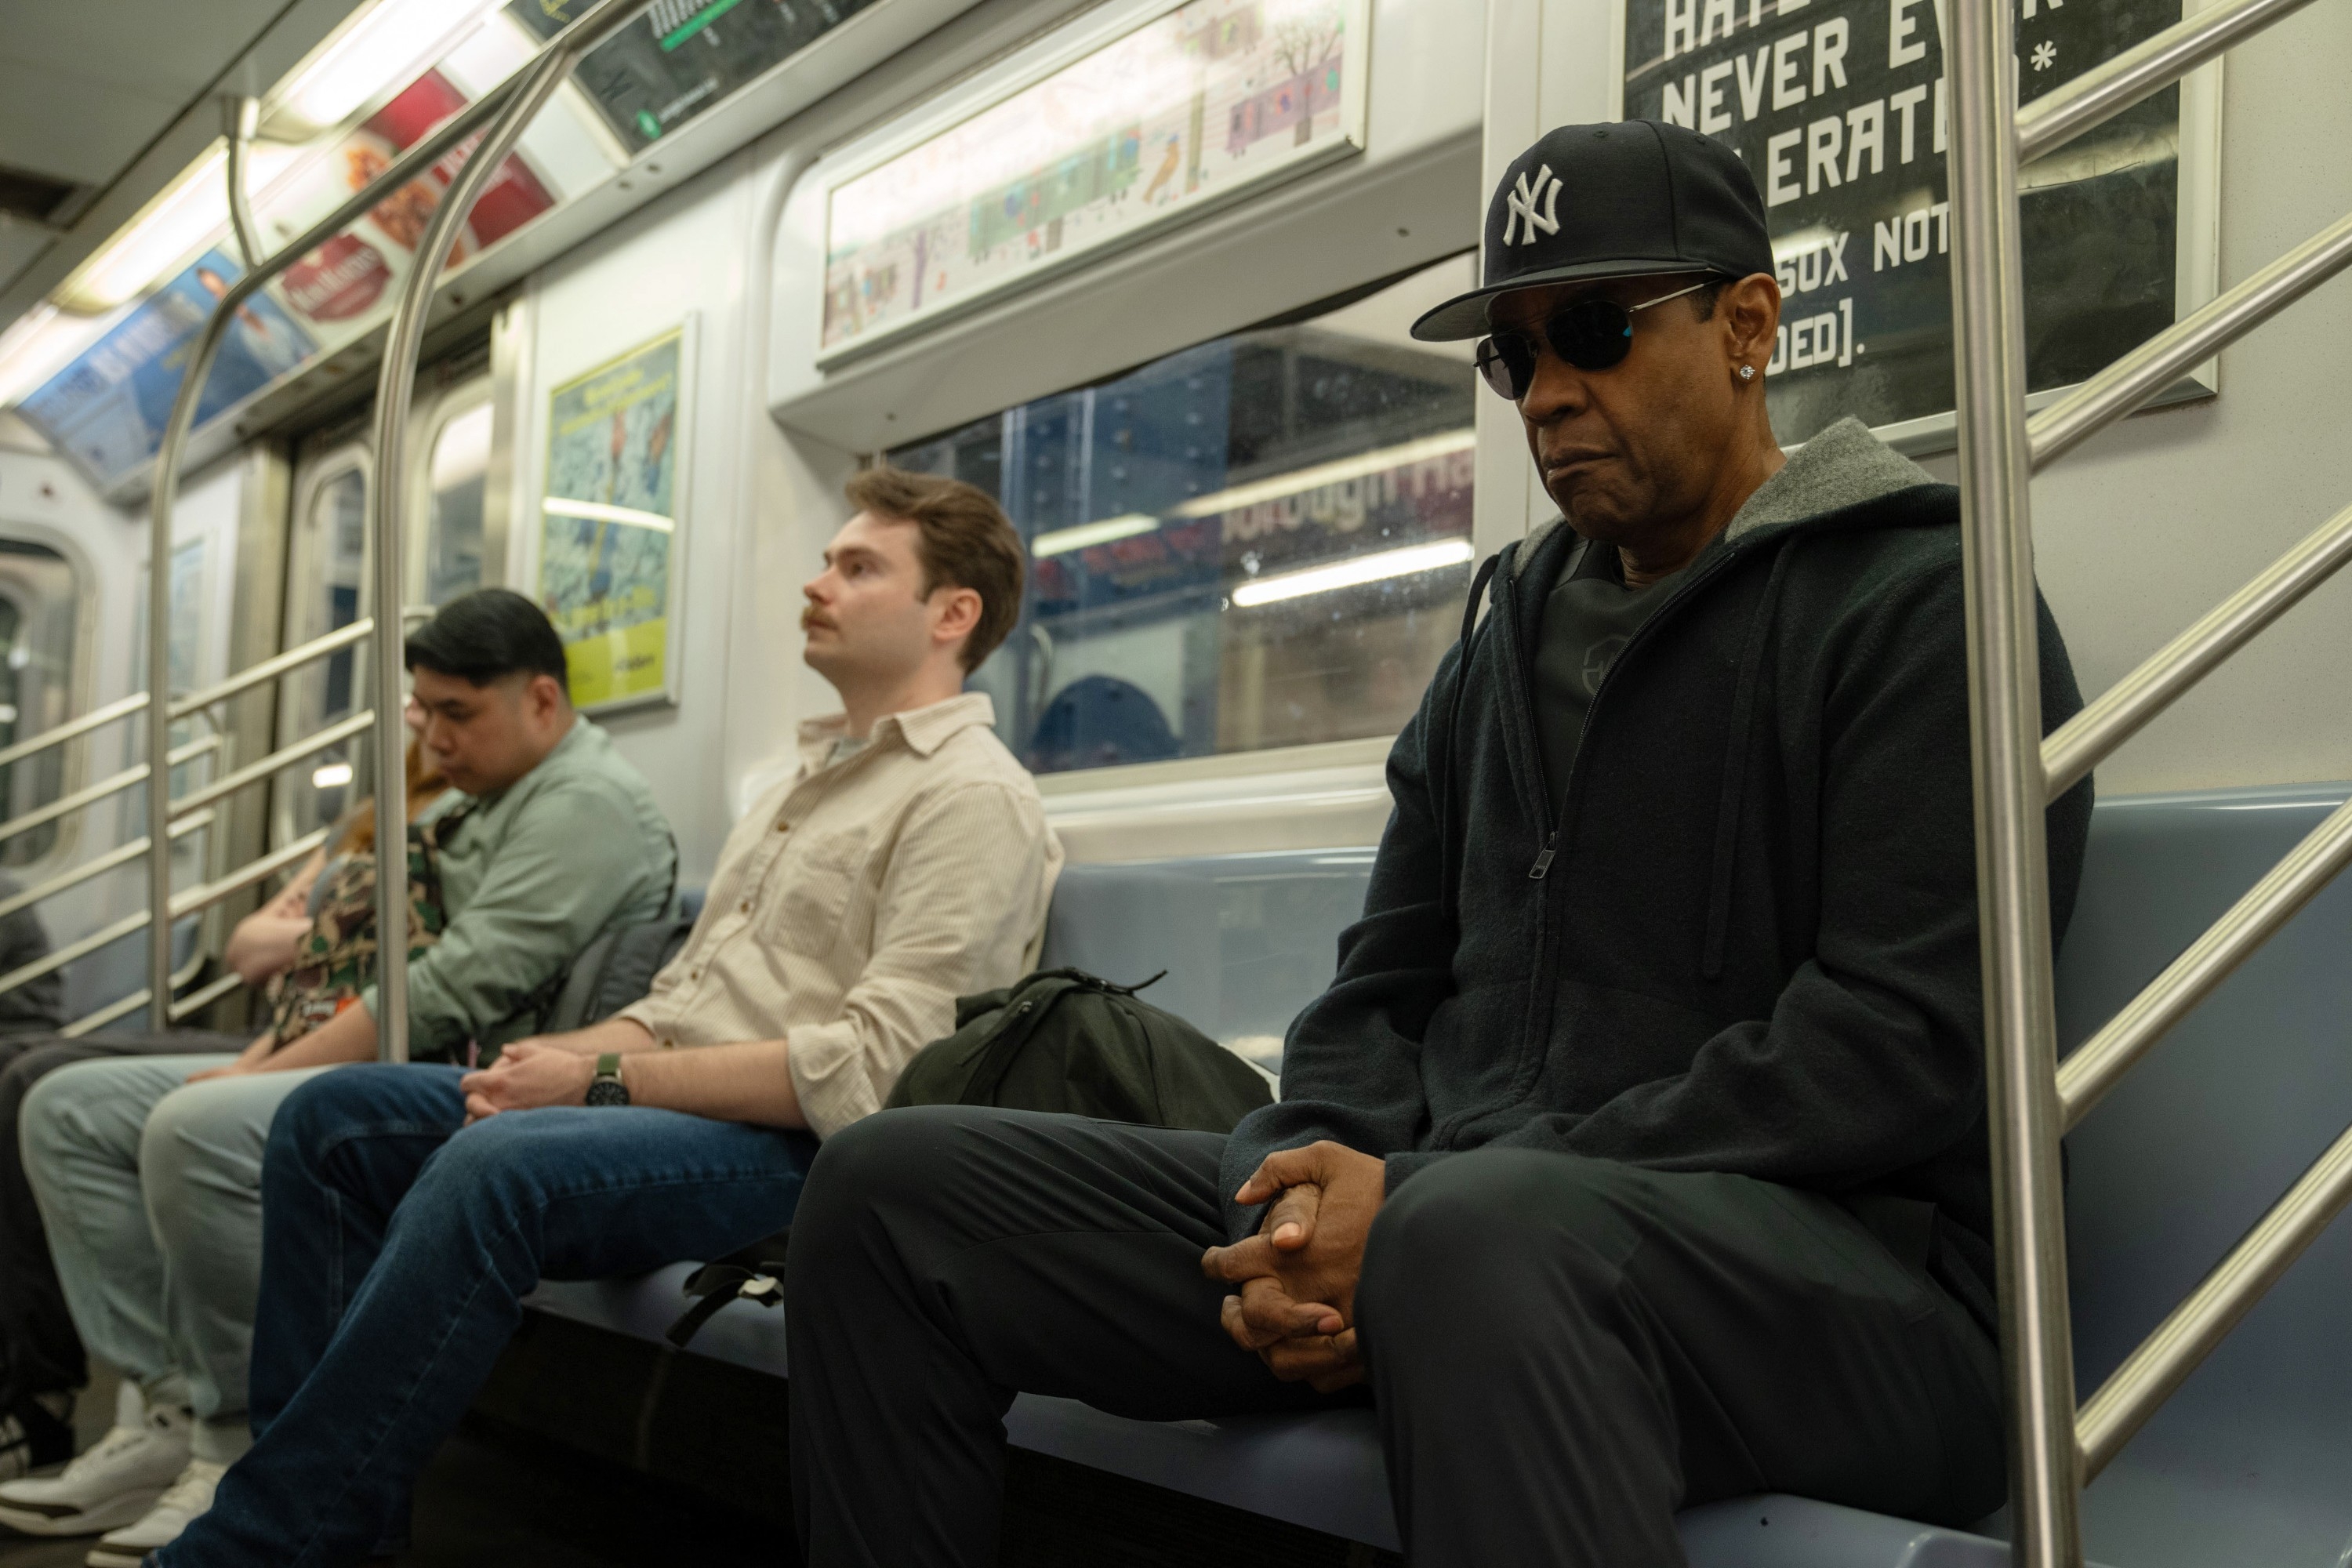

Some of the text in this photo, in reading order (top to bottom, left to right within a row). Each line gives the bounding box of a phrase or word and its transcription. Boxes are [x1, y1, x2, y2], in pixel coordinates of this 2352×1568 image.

[1664, 0, 1812, 61] HA
[1662, 16, 1849, 136] NEVER
[1503, 163, 1564, 246] NY
[1874, 201, 1949, 272] NOT
